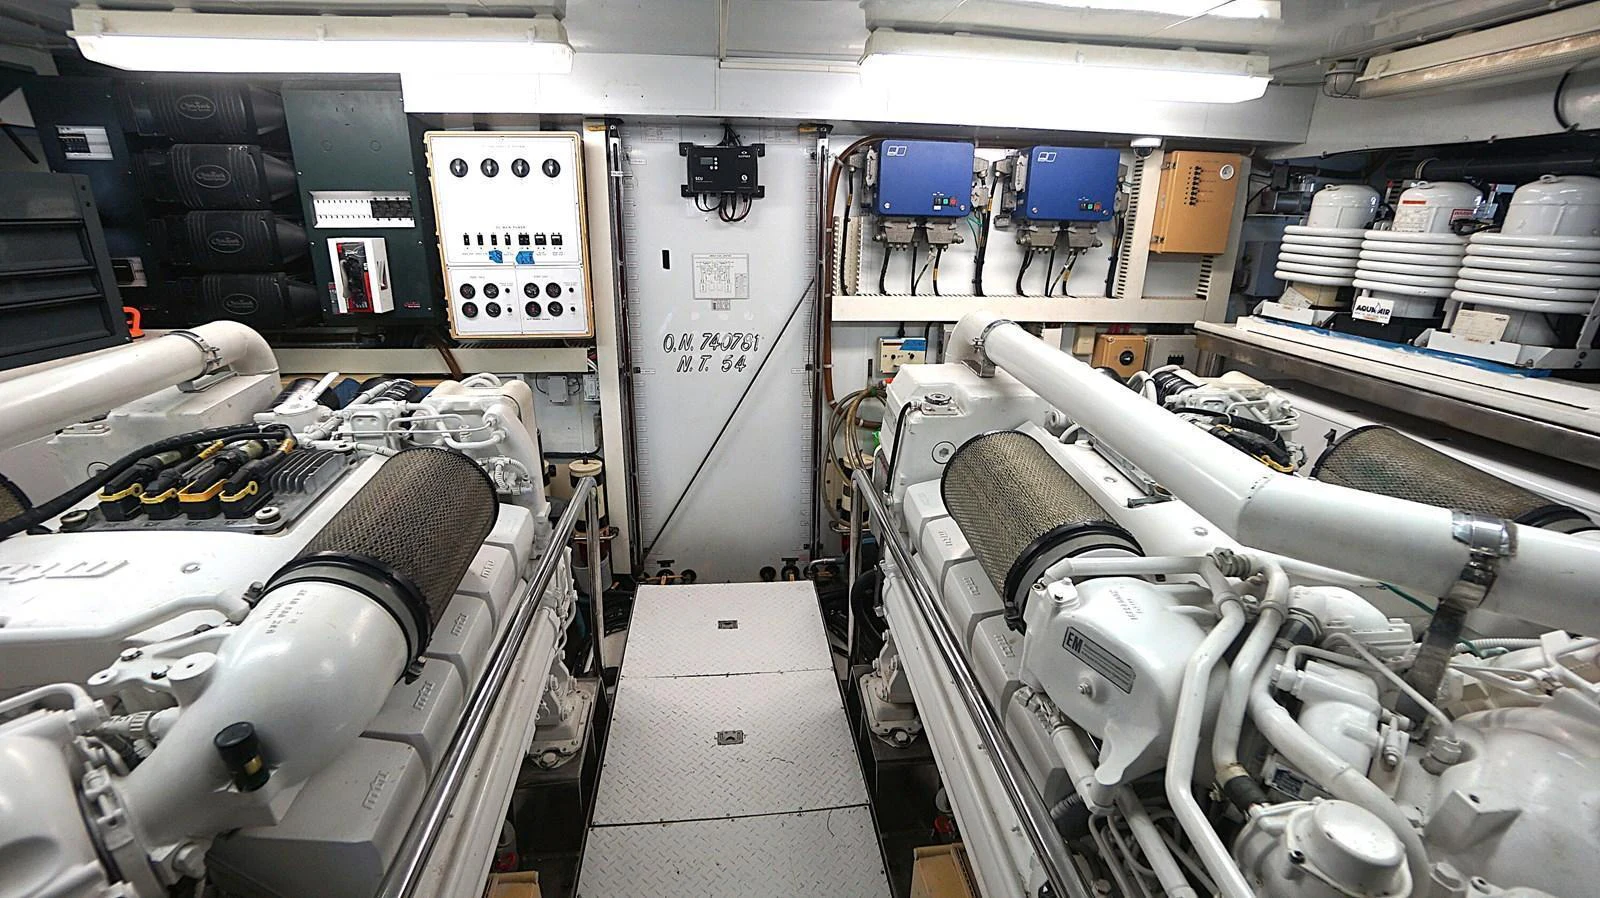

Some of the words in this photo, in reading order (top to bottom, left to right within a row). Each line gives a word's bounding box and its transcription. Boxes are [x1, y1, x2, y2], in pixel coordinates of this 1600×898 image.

[1355, 304, 1376, 314] AQUA
[1377, 308, 1391, 316] AIR
[700, 332, 760, 352] 740781
[721, 354, 747, 373] 54
[1065, 631, 1084, 654] EM
[413, 680, 437, 711] mtu
[362, 769, 391, 810] mtu
